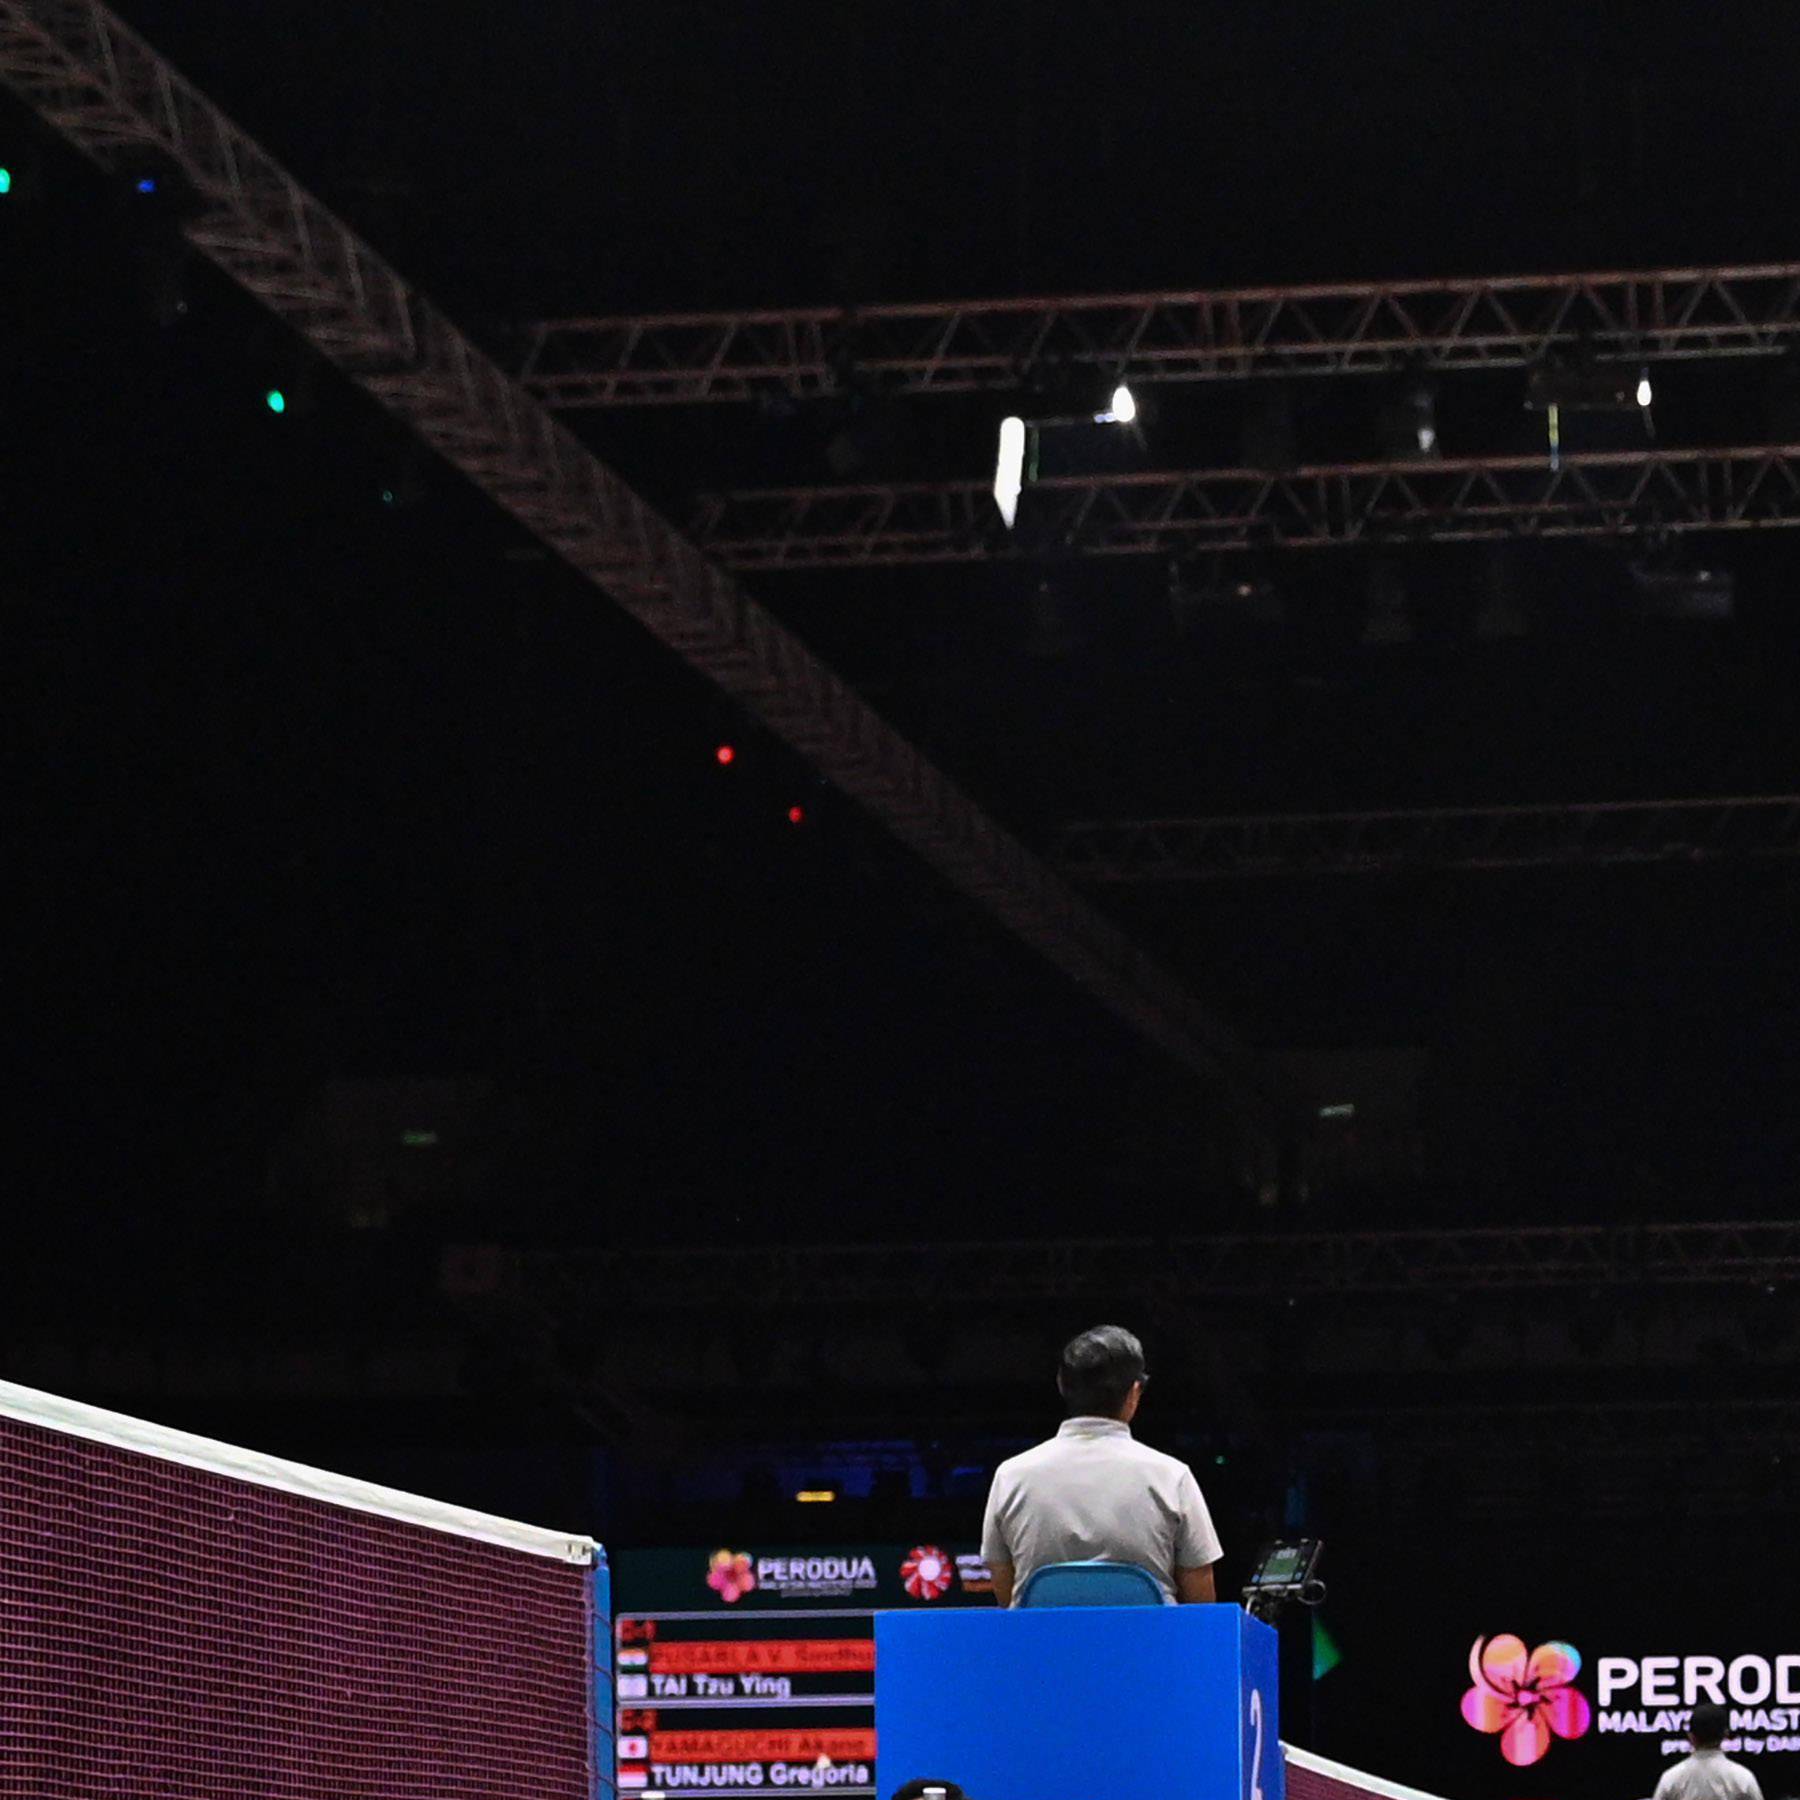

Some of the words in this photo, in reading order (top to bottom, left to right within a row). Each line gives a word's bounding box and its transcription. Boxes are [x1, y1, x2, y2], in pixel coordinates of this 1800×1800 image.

[758, 1557, 876, 1581] PERODUA
[651, 1674, 687, 1695] TAI
[692, 1673, 735, 1695] Tzu
[740, 1672, 792, 1699] Ying
[651, 1763, 763, 1787] TUNJUNG
[769, 1761, 869, 1788] Gregoria
